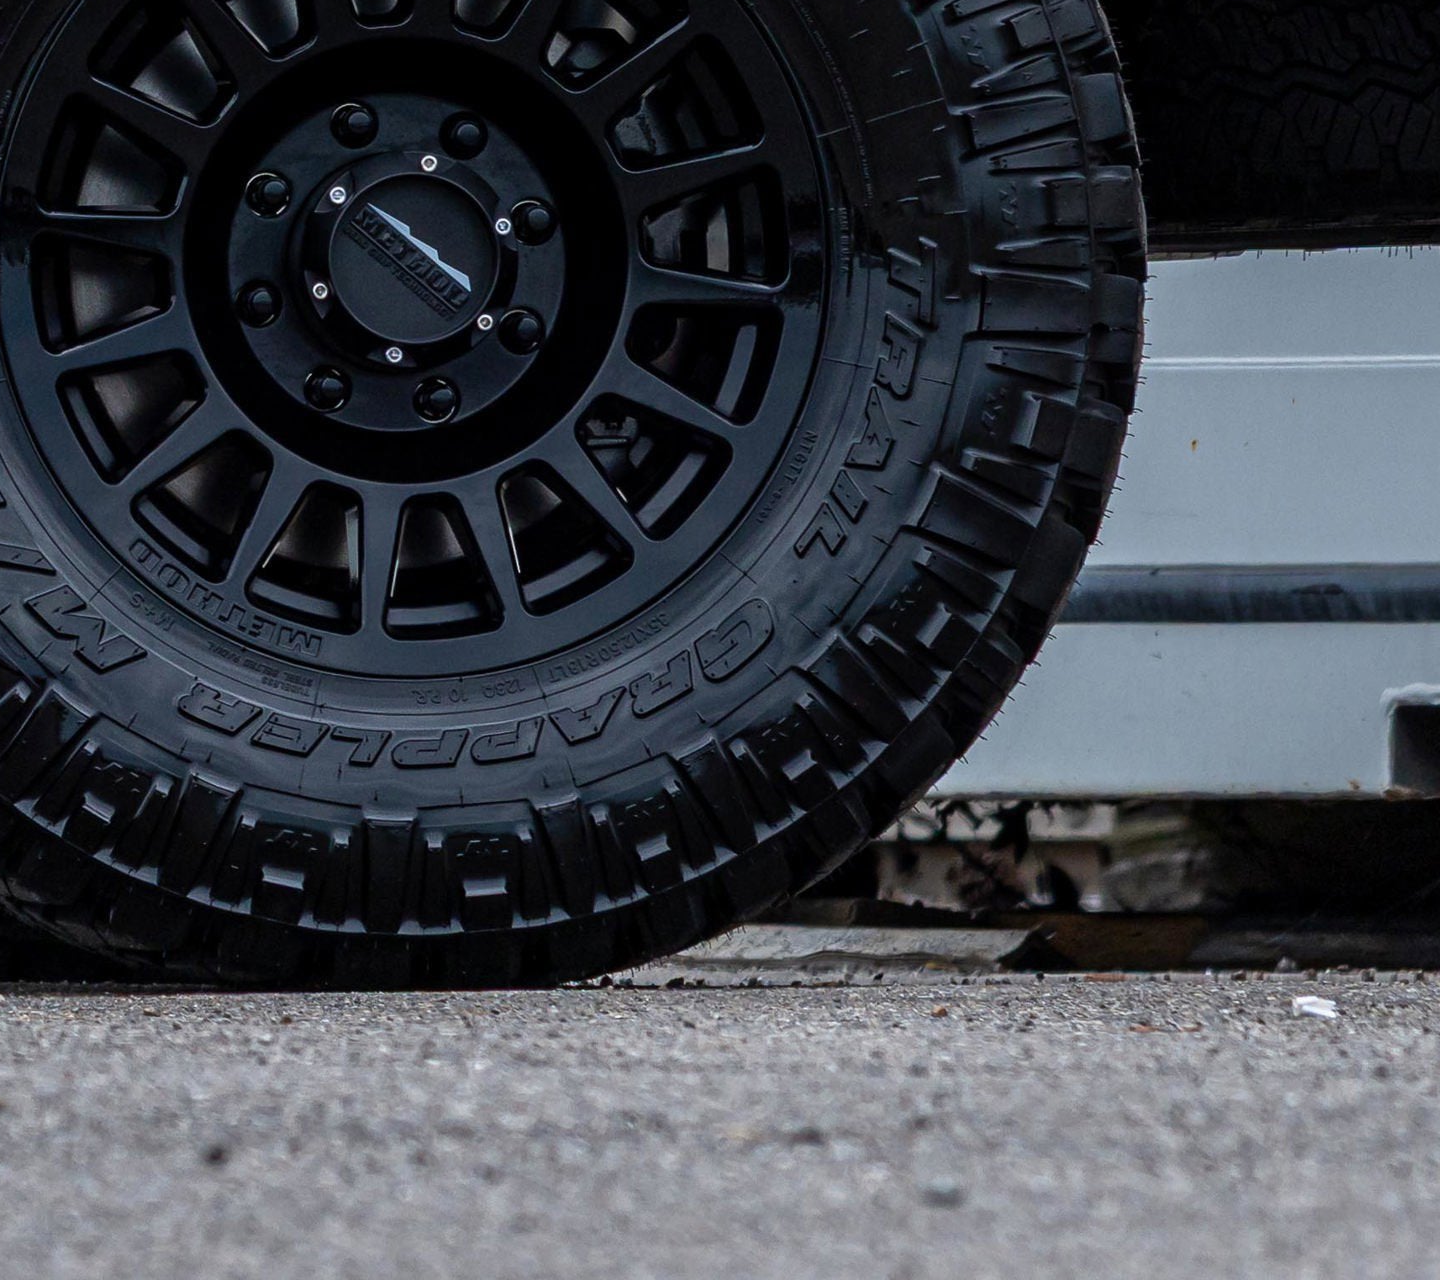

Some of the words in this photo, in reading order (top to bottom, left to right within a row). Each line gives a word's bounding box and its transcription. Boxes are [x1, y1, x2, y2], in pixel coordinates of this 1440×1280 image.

[792, 237, 937, 563] TRAIL
[125, 536, 324, 656] METHOD
[177, 596, 778, 770] GRAPPLER
